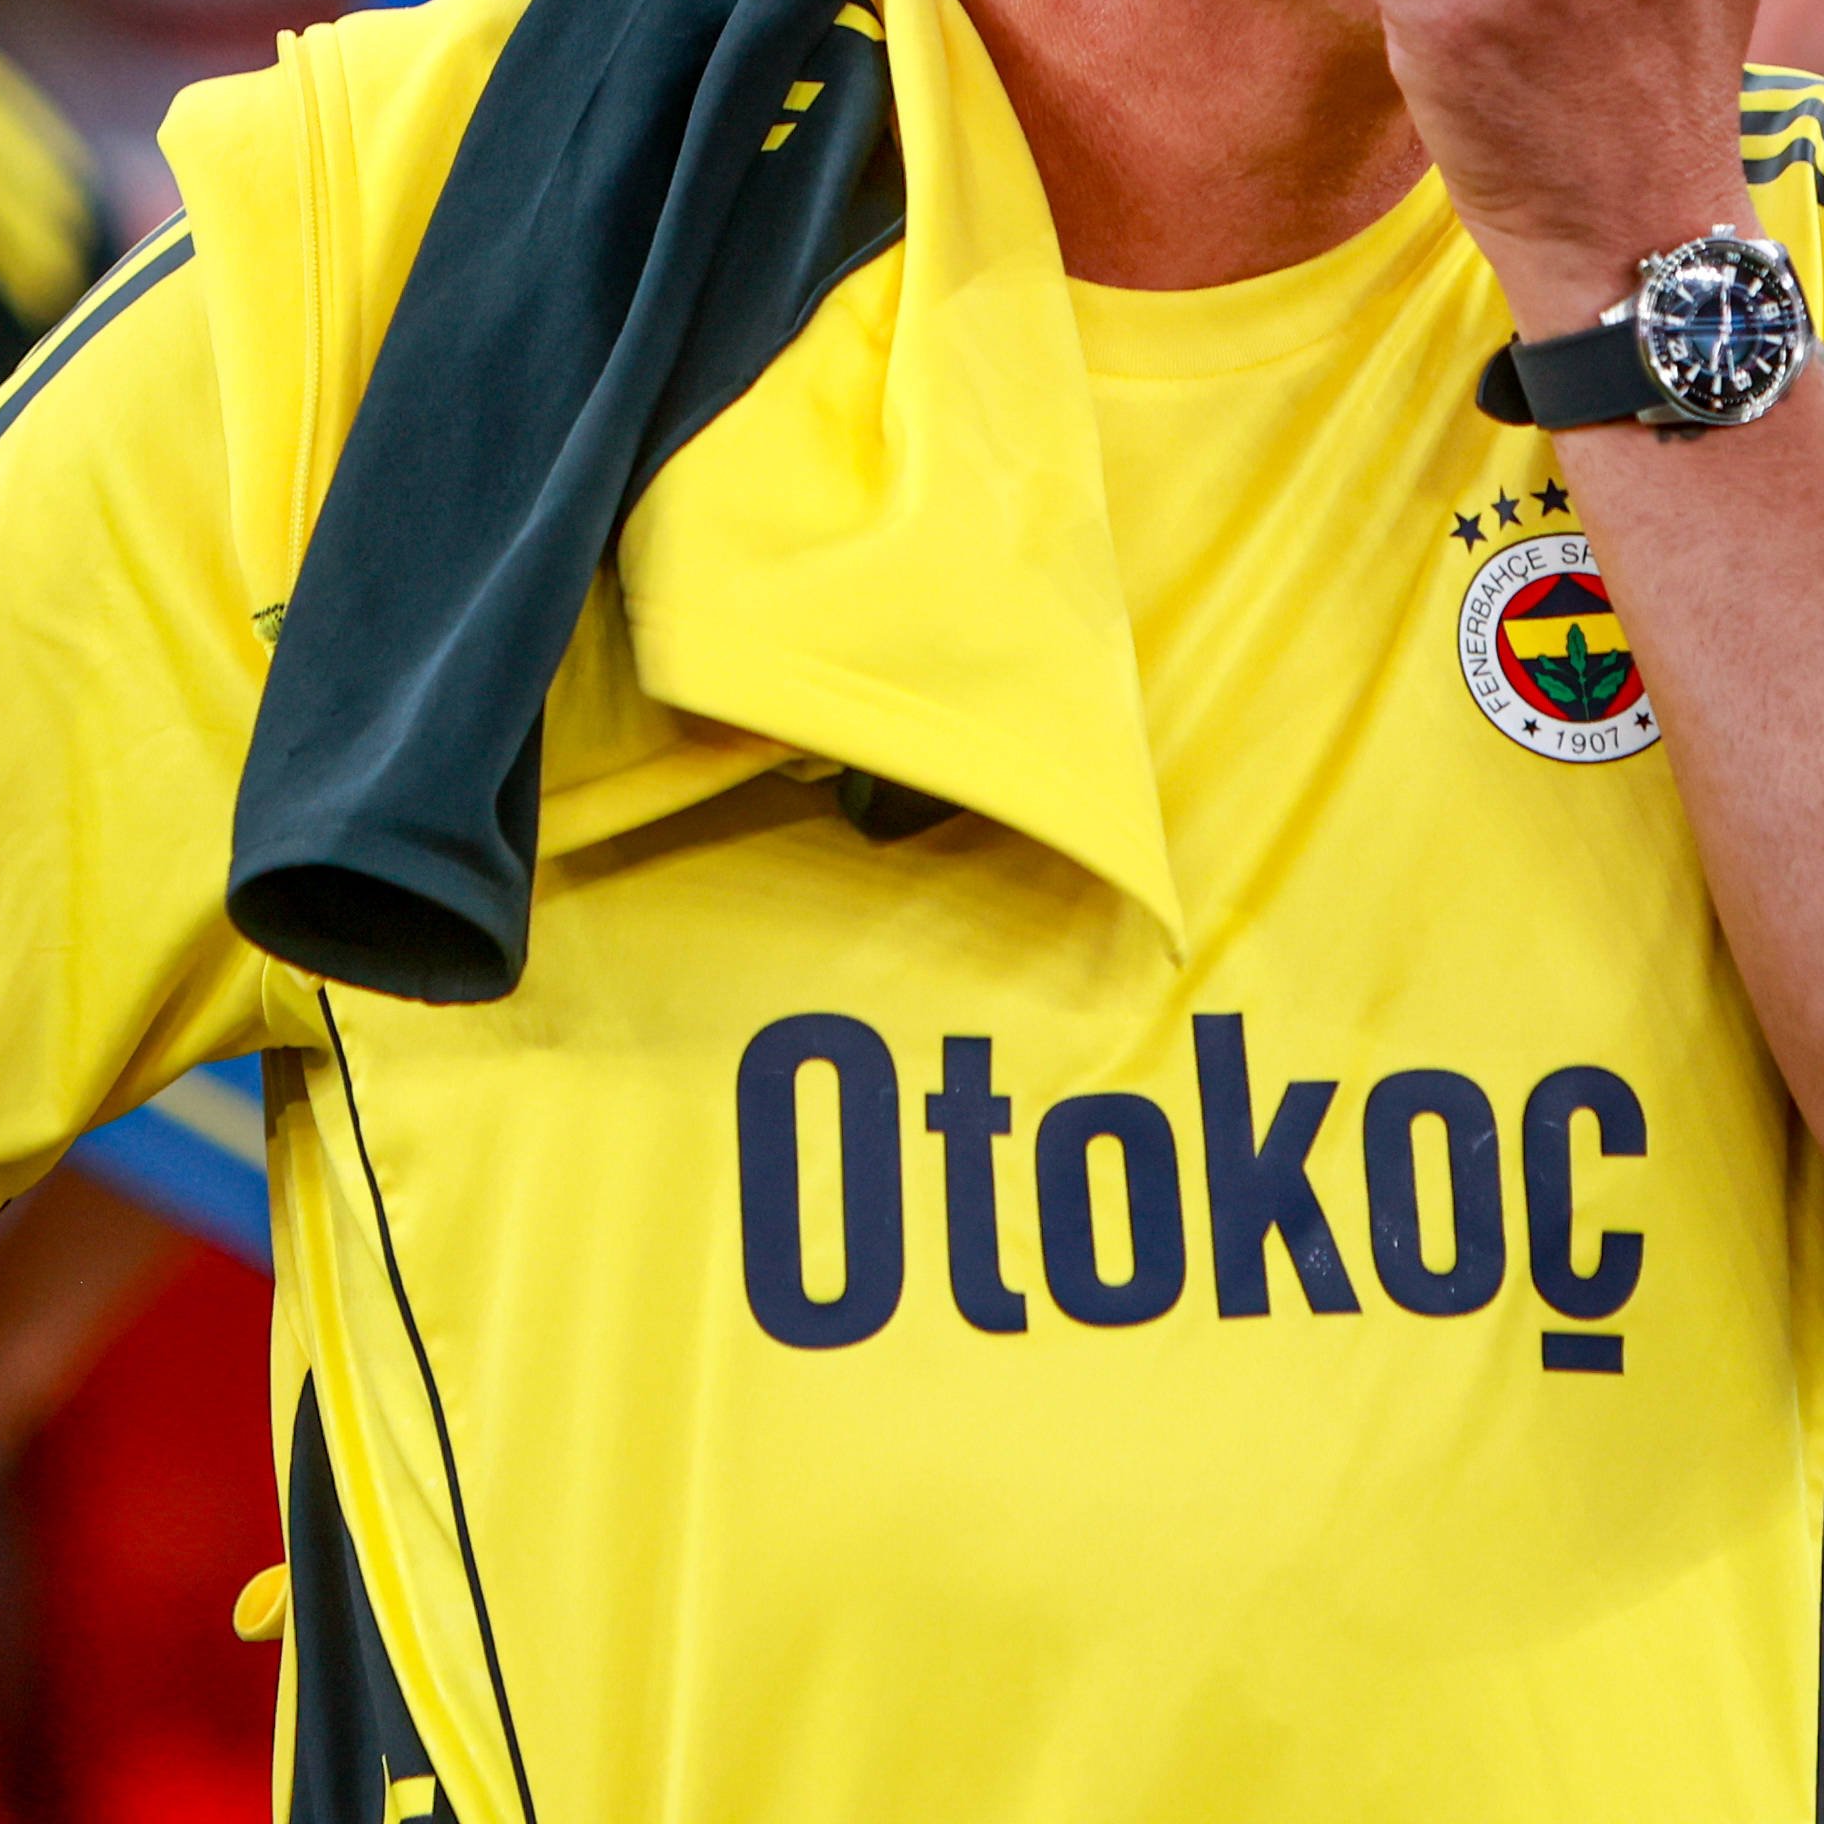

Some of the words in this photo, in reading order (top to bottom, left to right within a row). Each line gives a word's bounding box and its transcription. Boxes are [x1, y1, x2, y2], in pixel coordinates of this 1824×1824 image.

[1465, 545, 1548, 715] FENERBAHÇE
[1556, 727, 1621, 755] 1907
[735, 1011, 1648, 1375] Otokoç
